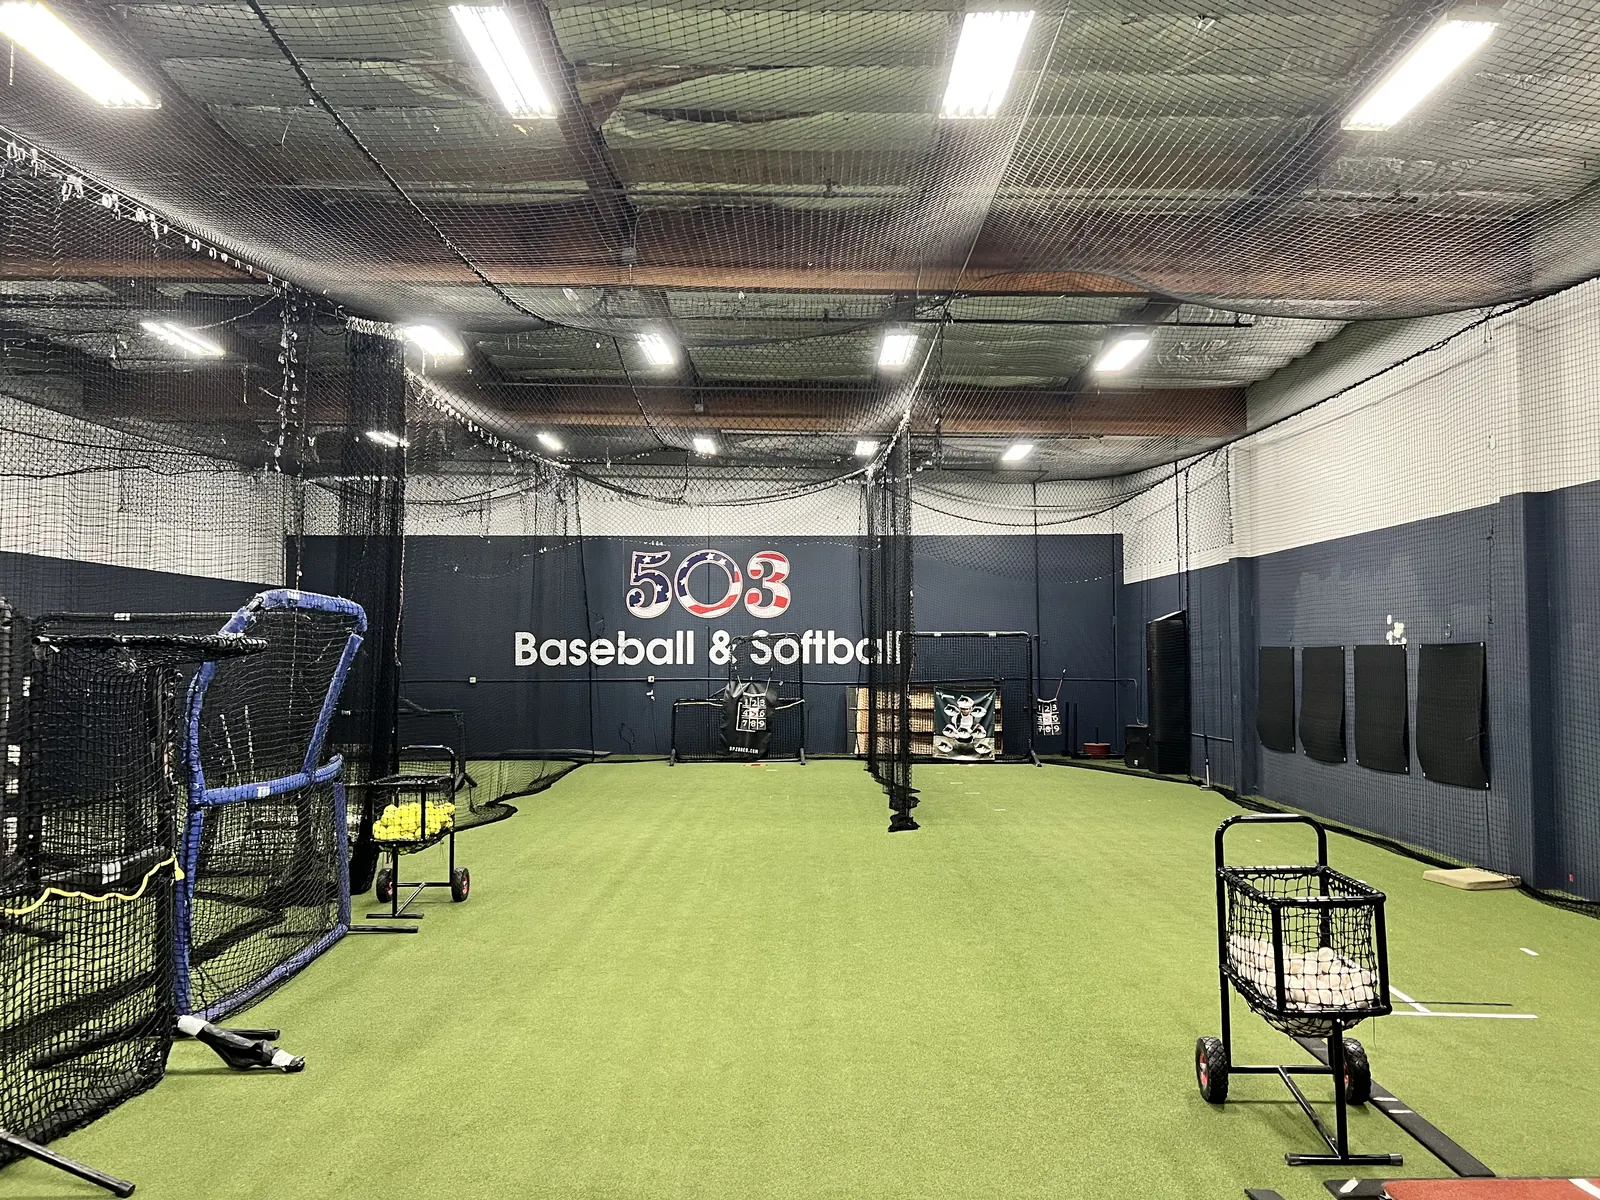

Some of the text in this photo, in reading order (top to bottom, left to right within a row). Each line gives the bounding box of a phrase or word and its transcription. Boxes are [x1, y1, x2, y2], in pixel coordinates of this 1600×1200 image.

[626, 549, 791, 619] 503
[514, 629, 902, 666] Baseball & Softball
